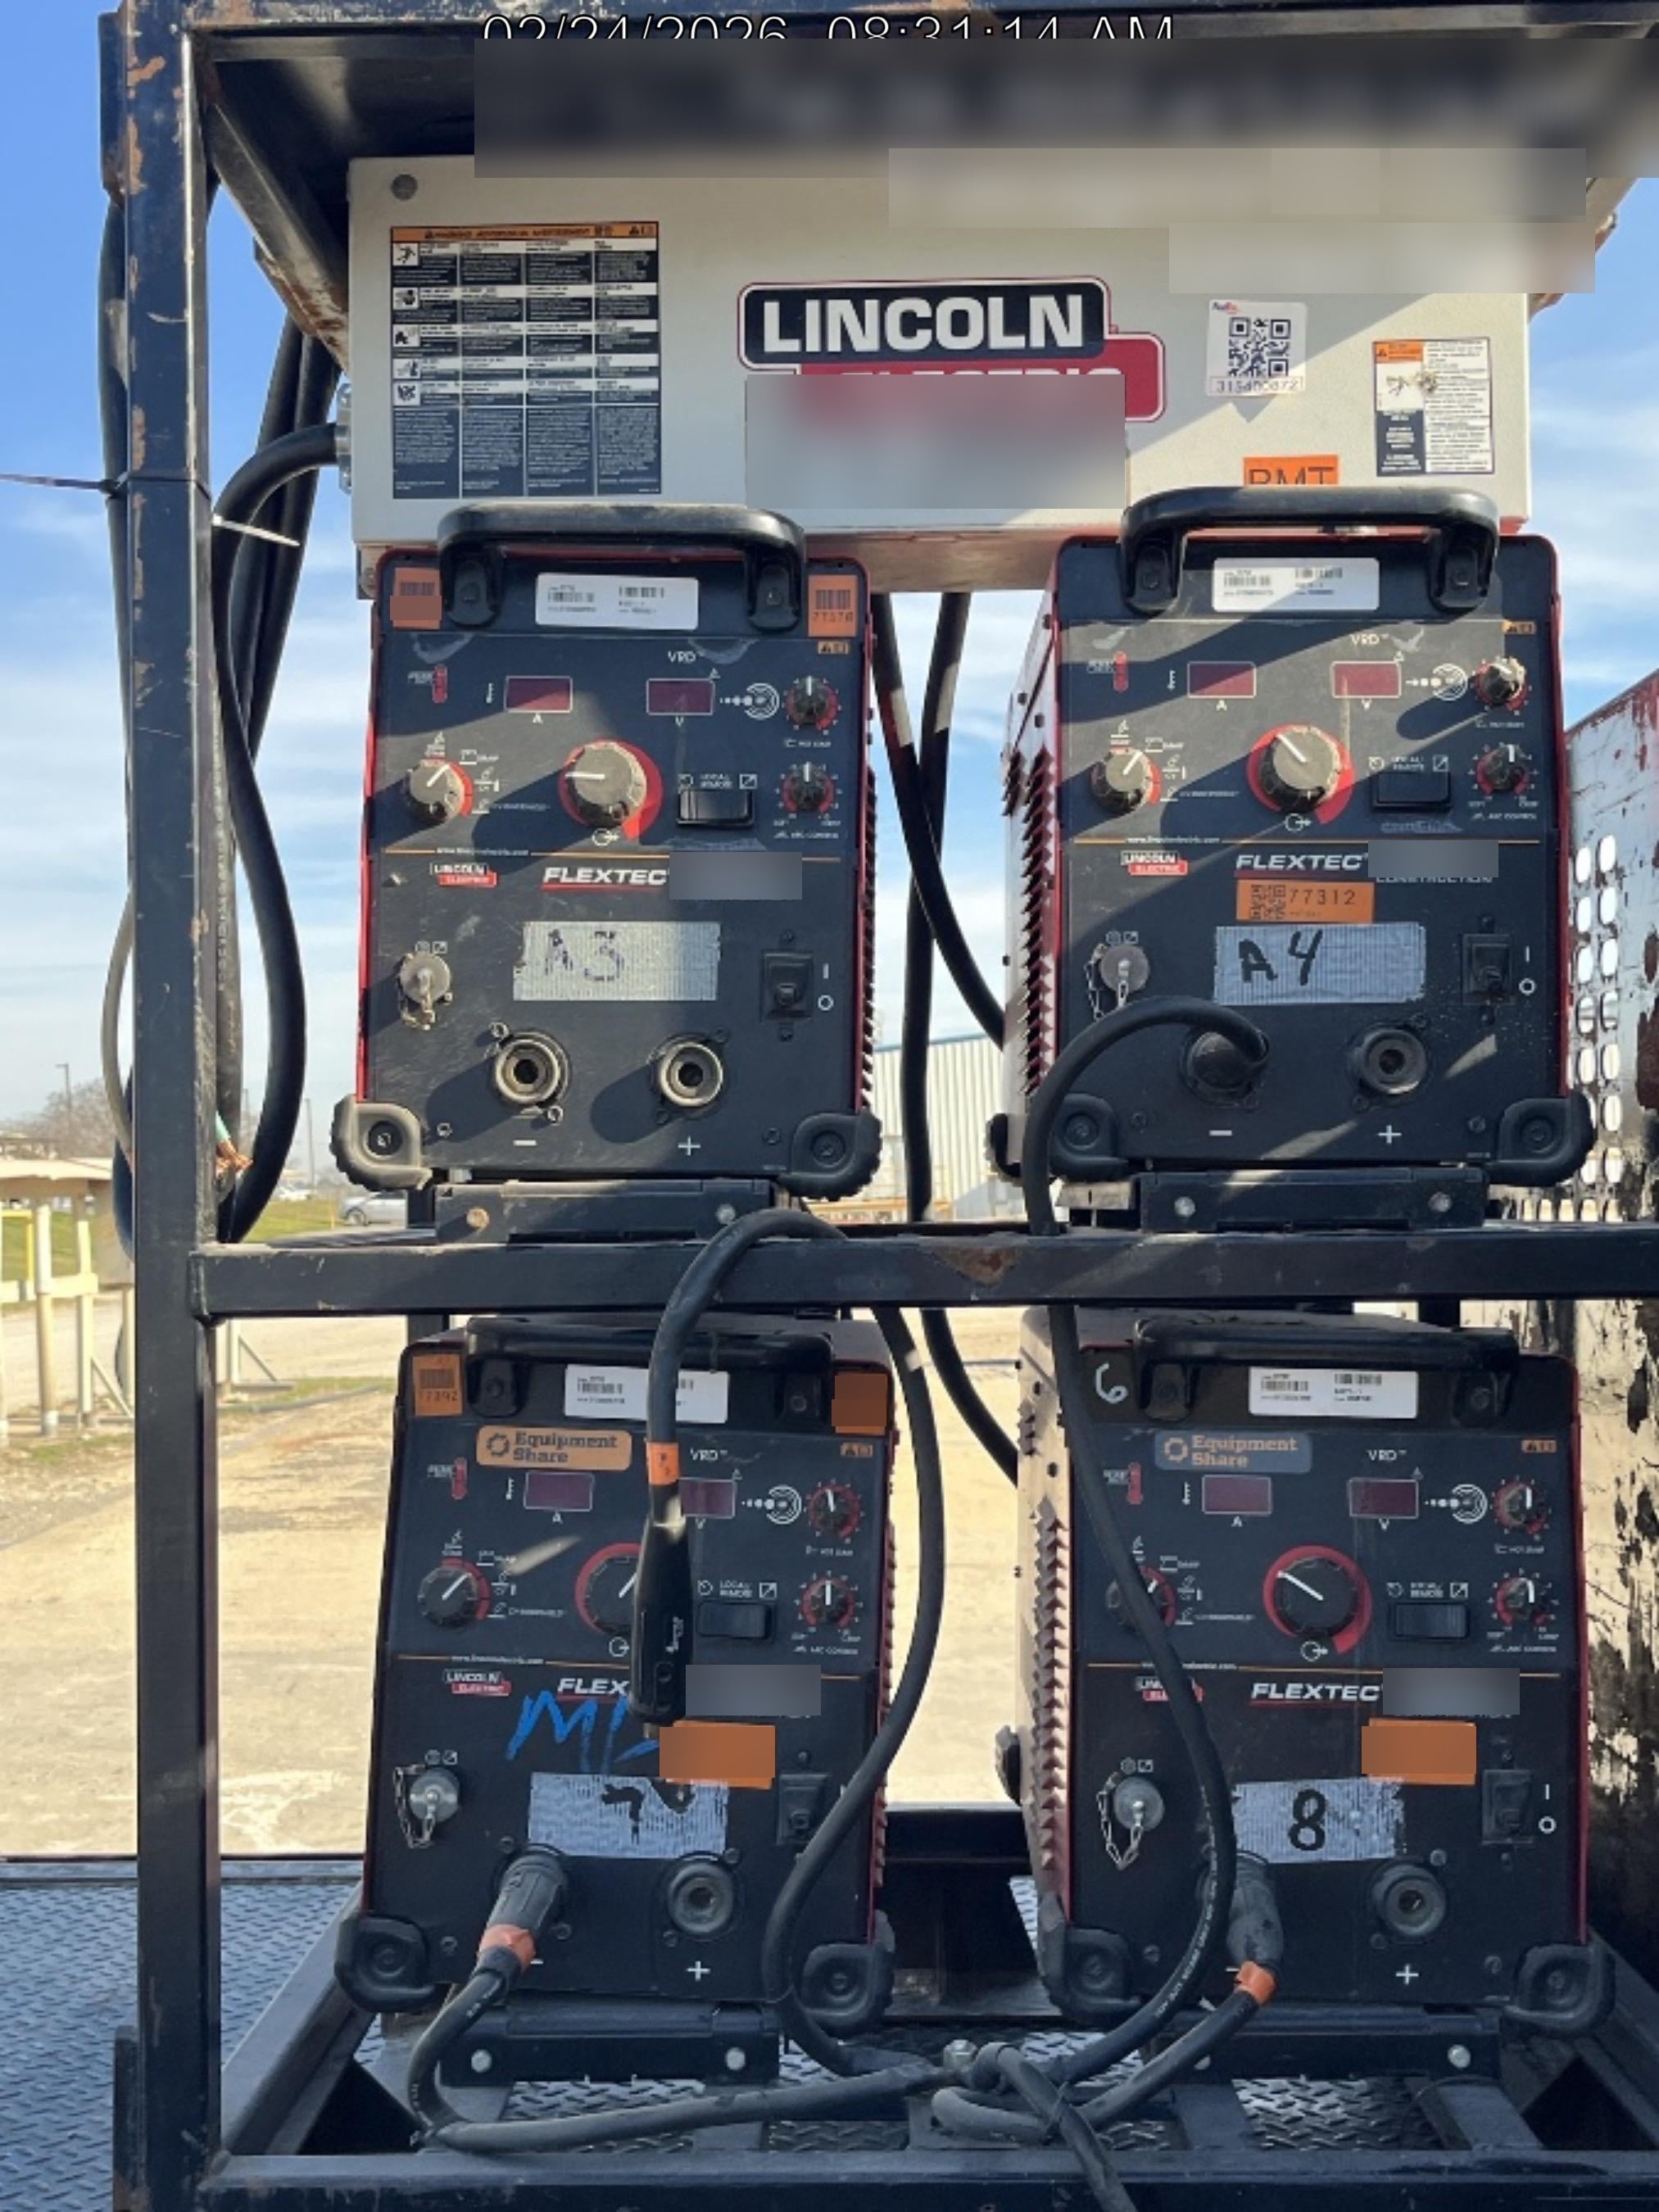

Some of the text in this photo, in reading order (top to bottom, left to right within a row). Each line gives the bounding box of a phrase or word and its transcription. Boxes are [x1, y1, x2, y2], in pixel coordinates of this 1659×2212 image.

[763, 294, 1083, 352] LINCOLN
[1235, 854, 1363, 870] FLEXTEC
[543, 867, 667, 885] FLEXTEC
[1290, 889, 1356, 905] 77312
[1095, 1362, 1128, 1403] 6
[515, 1430, 617, 1450] Equipment
[1192, 1435, 1299, 1453] Equipment
[513, 1446, 569, 1462] Share
[1192, 1452, 1249, 1467] Share
[1251, 1683, 1380, 1702] FLEXTEC
[1289, 1788, 1327, 1852] 8
